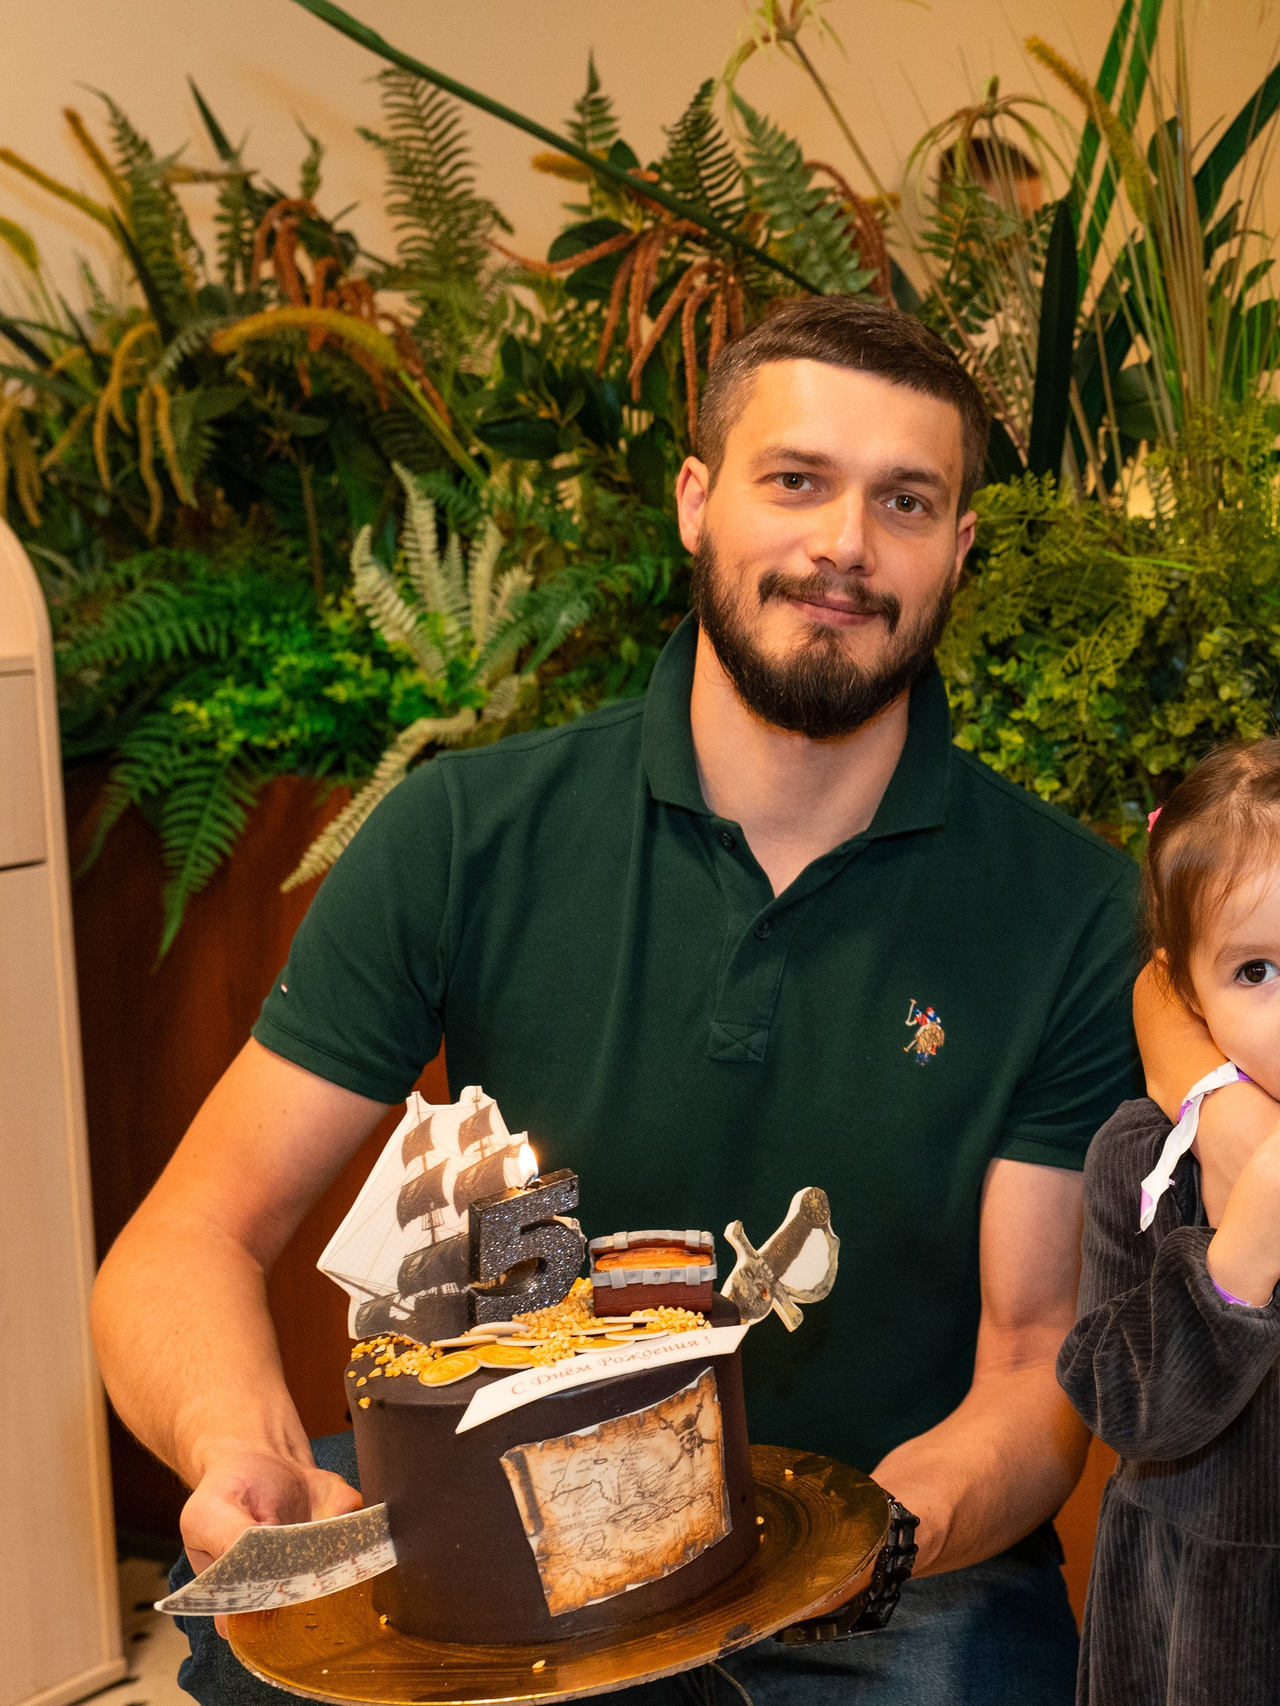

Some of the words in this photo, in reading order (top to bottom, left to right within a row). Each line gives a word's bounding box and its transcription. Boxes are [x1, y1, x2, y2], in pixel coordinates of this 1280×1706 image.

[468, 1168, 585, 1325] 5
[511, 1382, 526, 1395] С
[530, 1364, 592, 1385] Днём
[597, 1339, 700, 1366] Рождения
